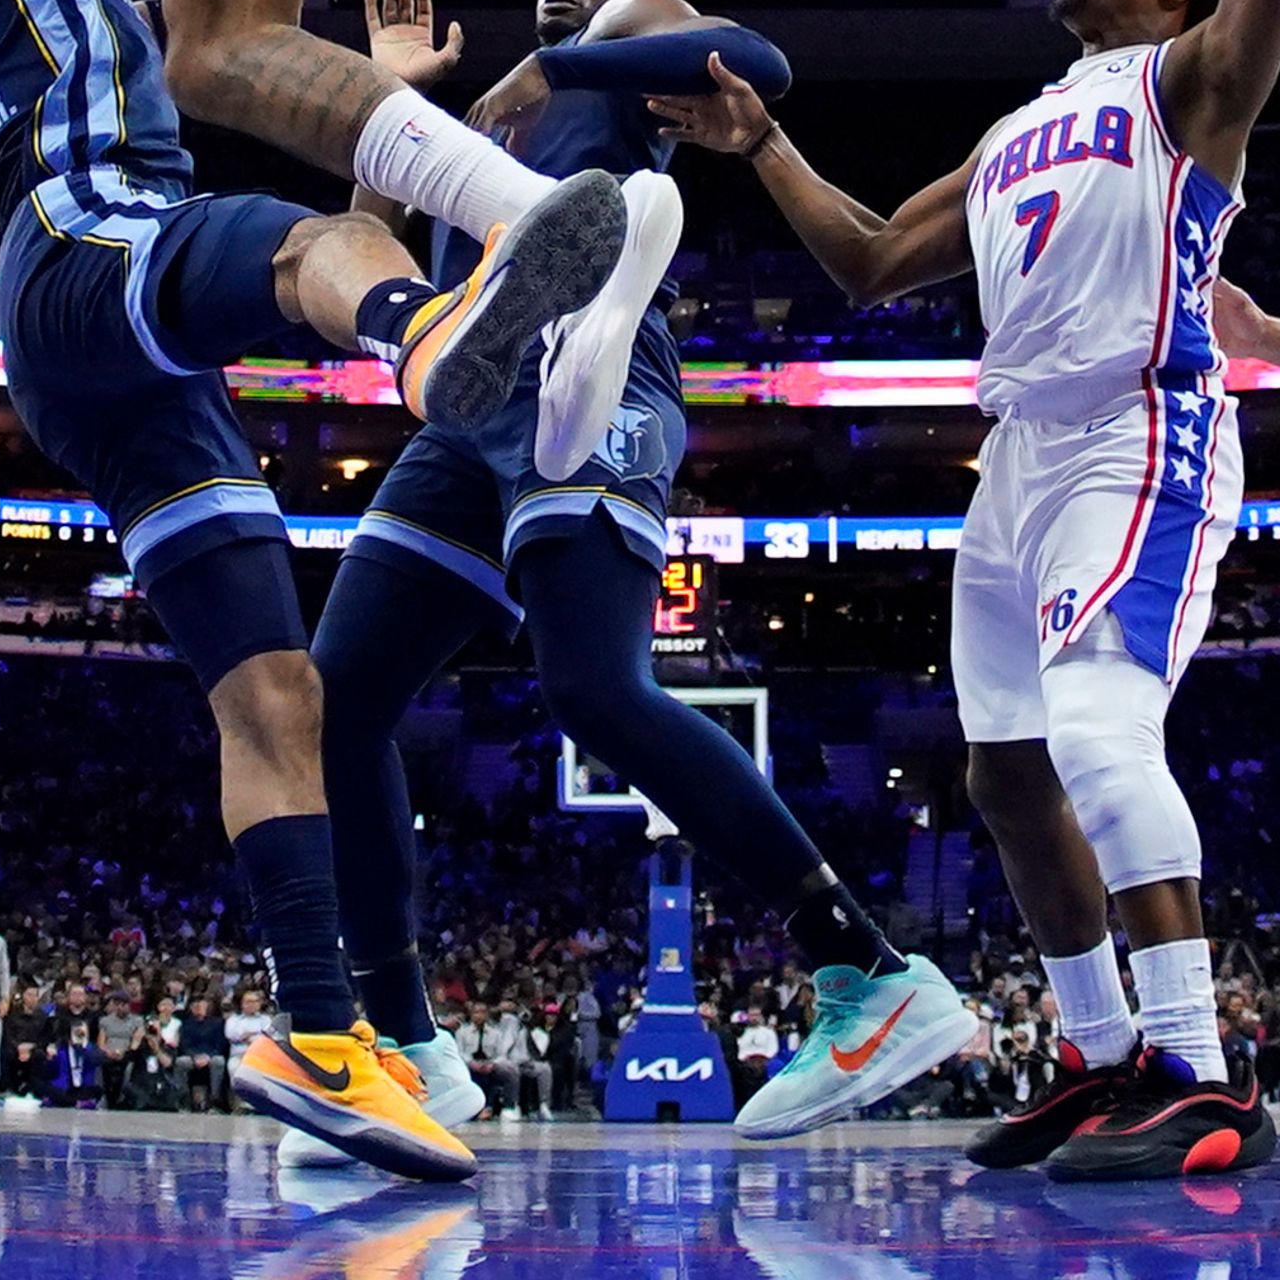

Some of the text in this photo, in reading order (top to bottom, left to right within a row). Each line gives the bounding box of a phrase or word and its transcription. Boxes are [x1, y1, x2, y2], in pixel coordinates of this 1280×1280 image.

[981, 105, 1134, 218] PHILA
[1014, 190, 1060, 278] 7
[1, 505, 51, 523] PLAYER
[1, 522, 72, 541] POINTS 0
[764, 521, 810, 558] 33
[1040, 588, 1077, 643] 76
